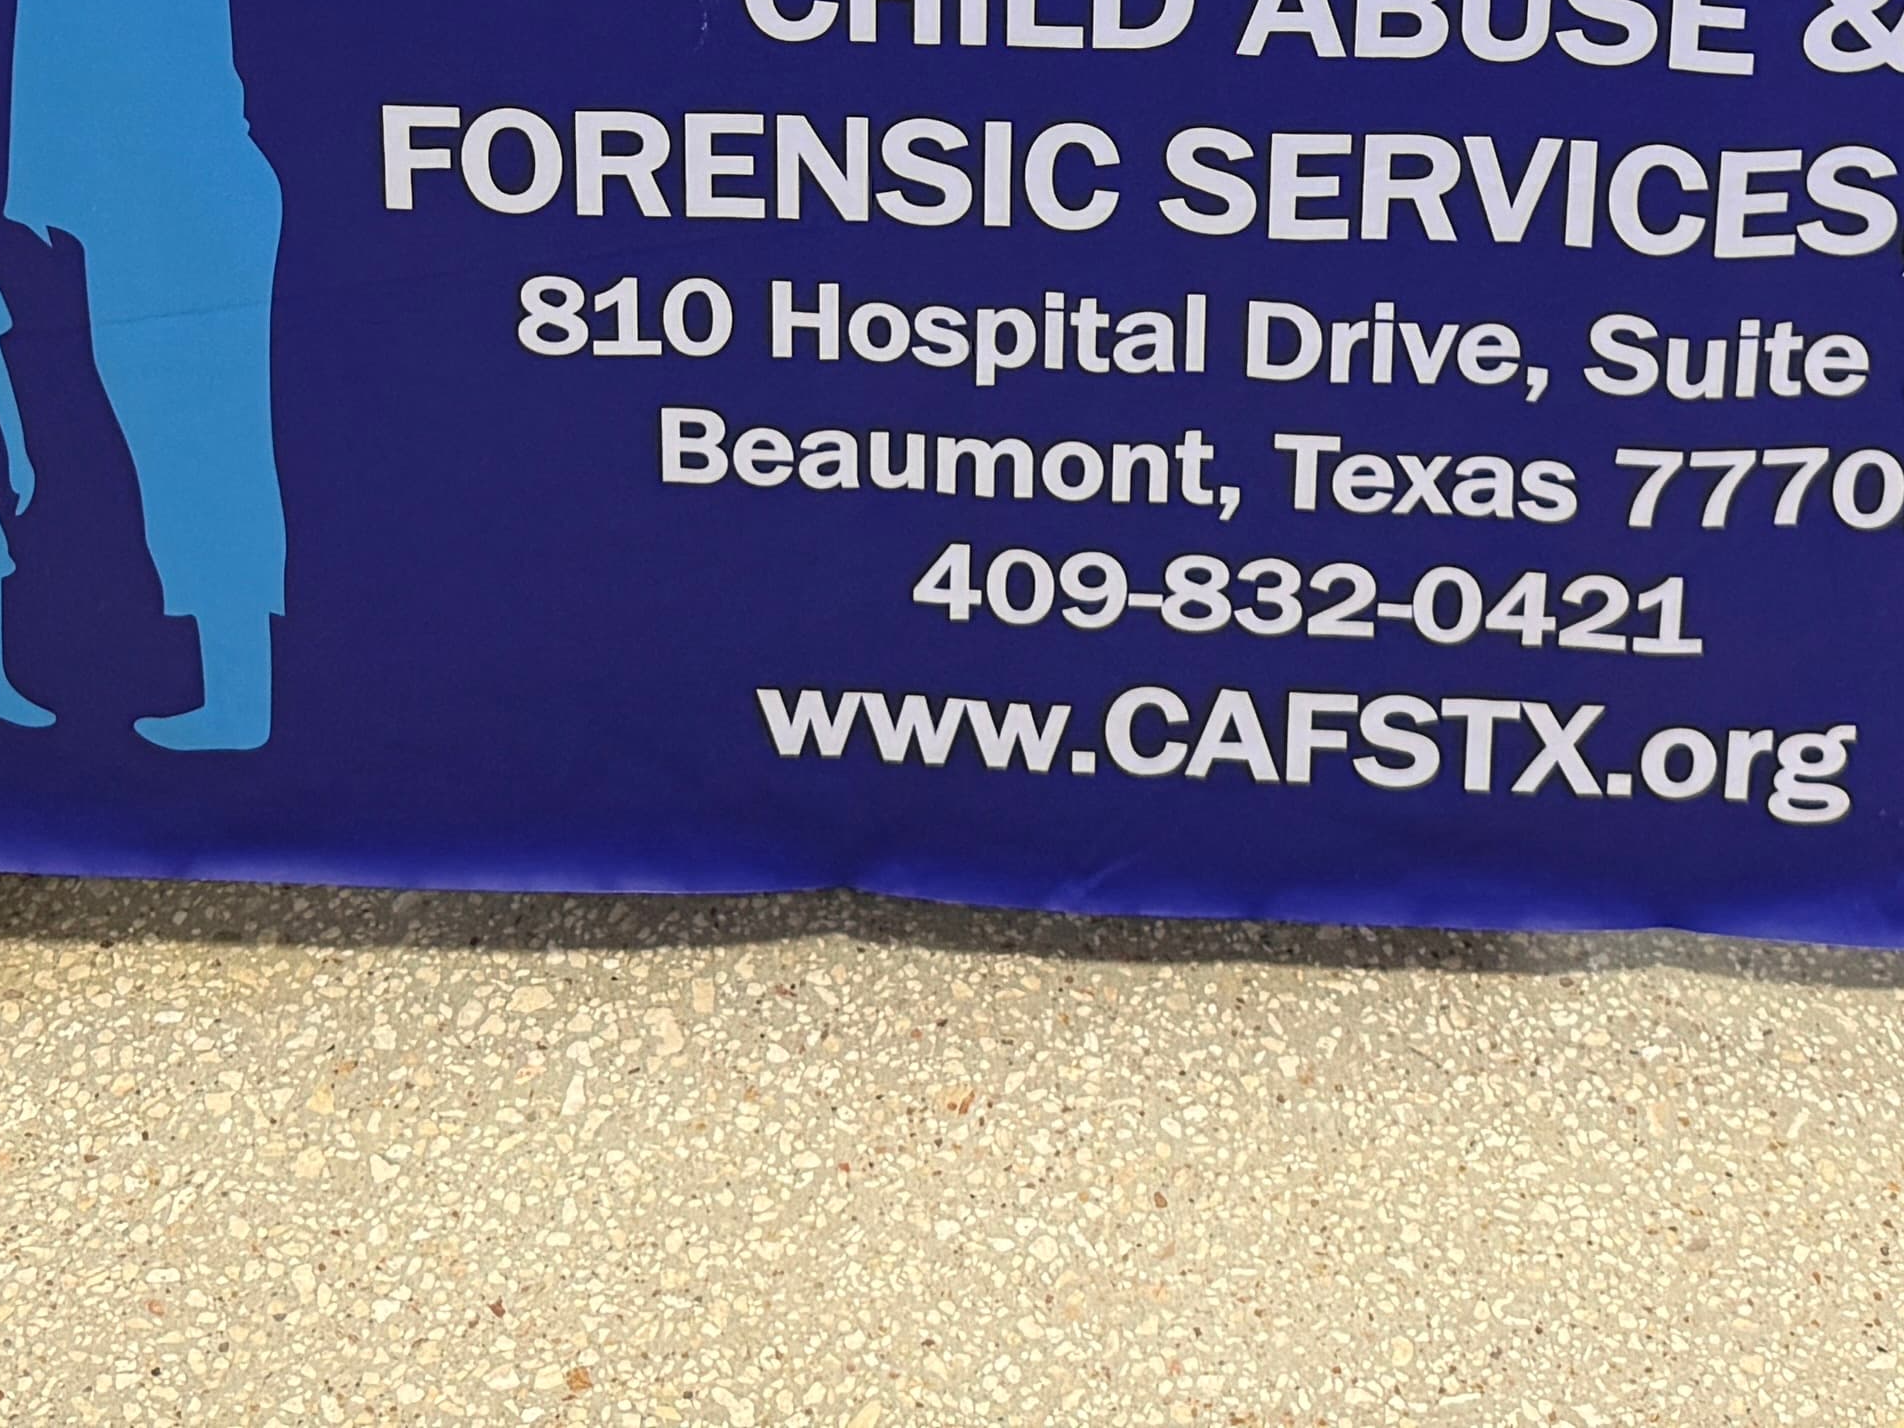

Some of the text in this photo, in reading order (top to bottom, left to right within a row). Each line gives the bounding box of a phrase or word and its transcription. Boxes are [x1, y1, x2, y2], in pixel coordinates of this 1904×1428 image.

[383, 105, 1120, 230] FORENSIC
[519, 276, 732, 355] 810
[773, 281, 1205, 385] Hospital
[1247, 301, 1547, 401] Drive,
[1584, 315, 1868, 398] Suite
[662, 408, 1239, 520] Beaumont,
[1275, 434, 1576, 521] Texas
[914, 544, 1701, 653] 409-832-0421
[757, 687, 1856, 822] www.CAFSTX.org
